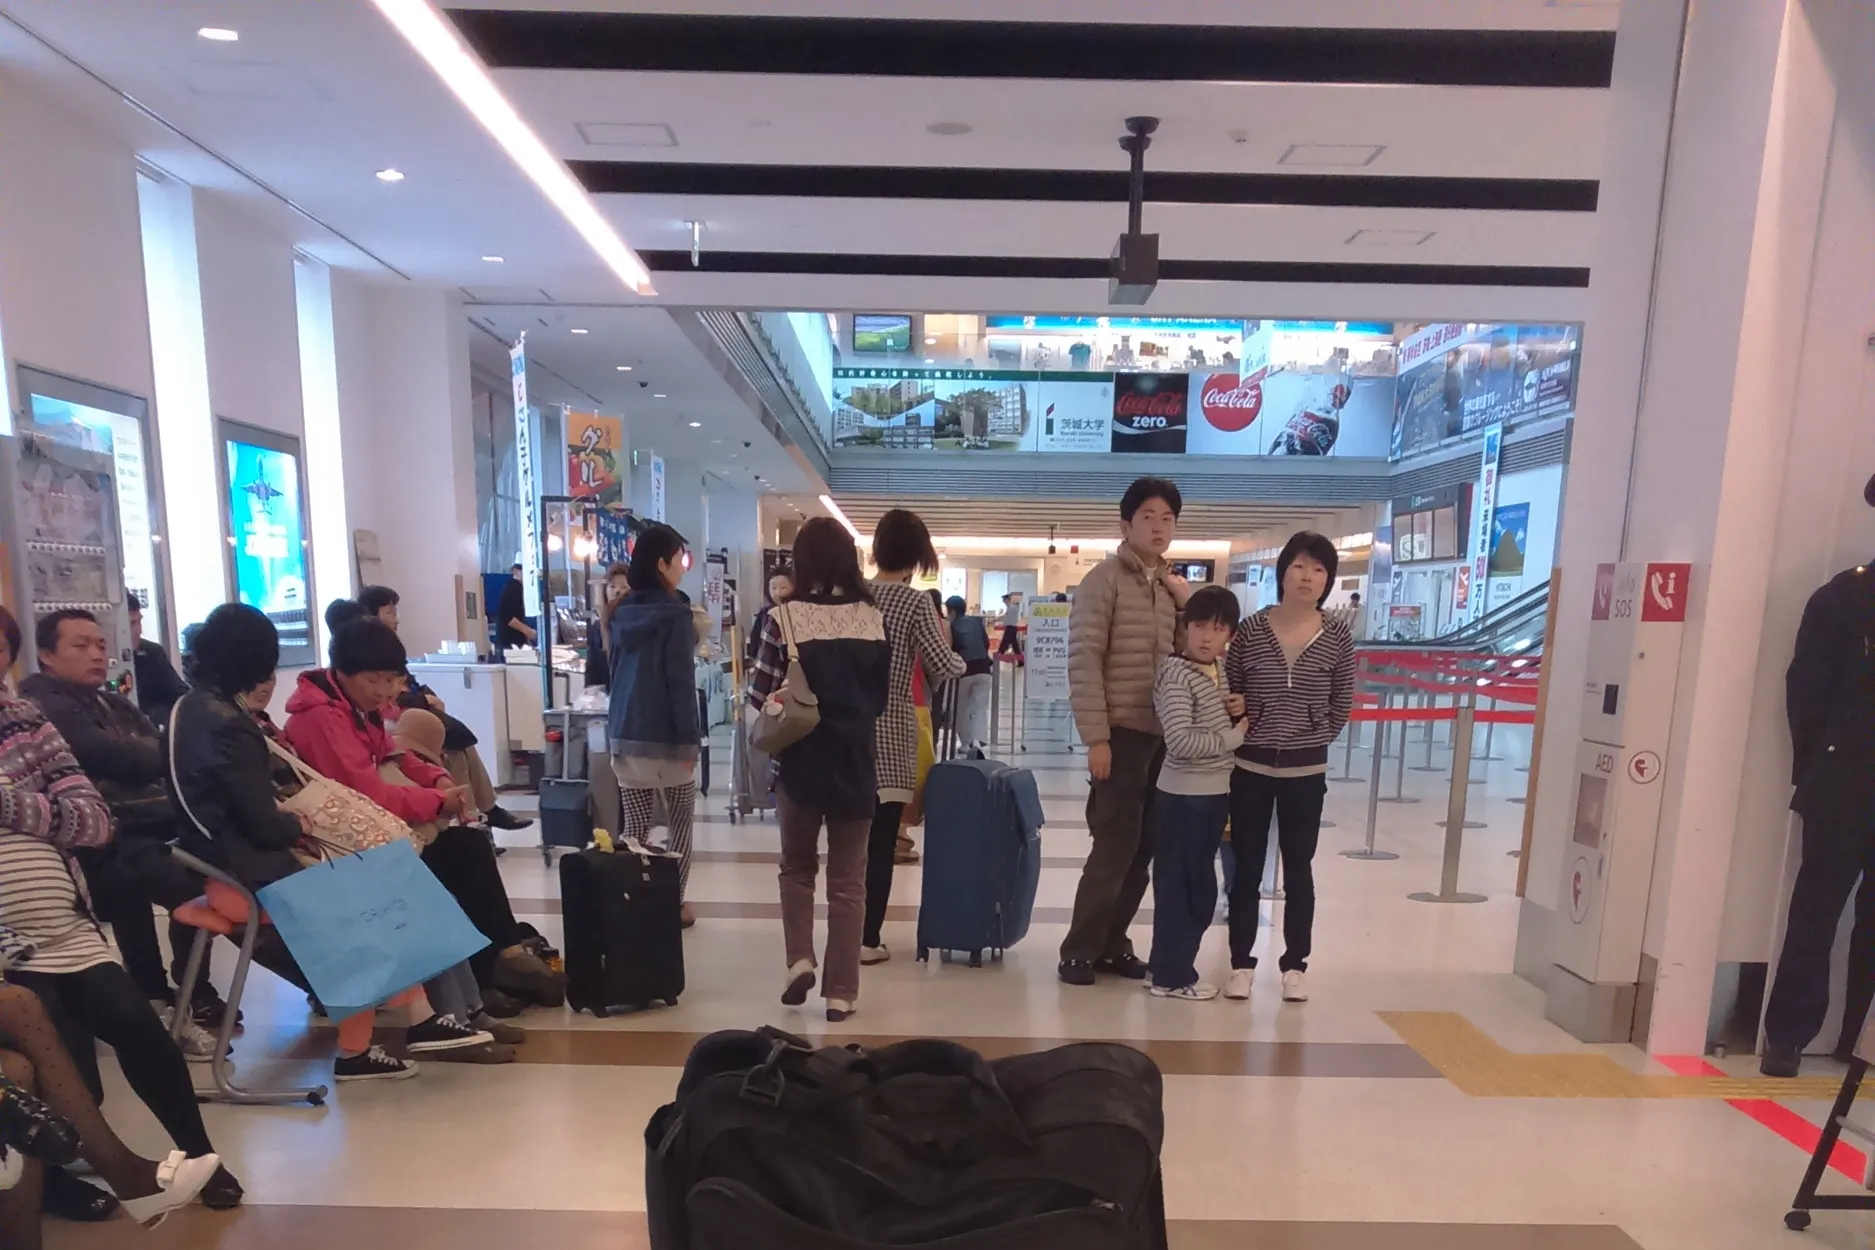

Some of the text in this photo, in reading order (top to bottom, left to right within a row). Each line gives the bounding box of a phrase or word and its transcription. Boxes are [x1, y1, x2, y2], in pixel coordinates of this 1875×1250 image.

[1060, 418, 1105, 430] 茨城大学
[1132, 416, 1167, 428] zero
[580, 423, 606, 500] グル
[1614, 598, 1633, 619] SOS
[1042, 618, 1060, 627] 入口
[1594, 753, 1614, 774] AED
